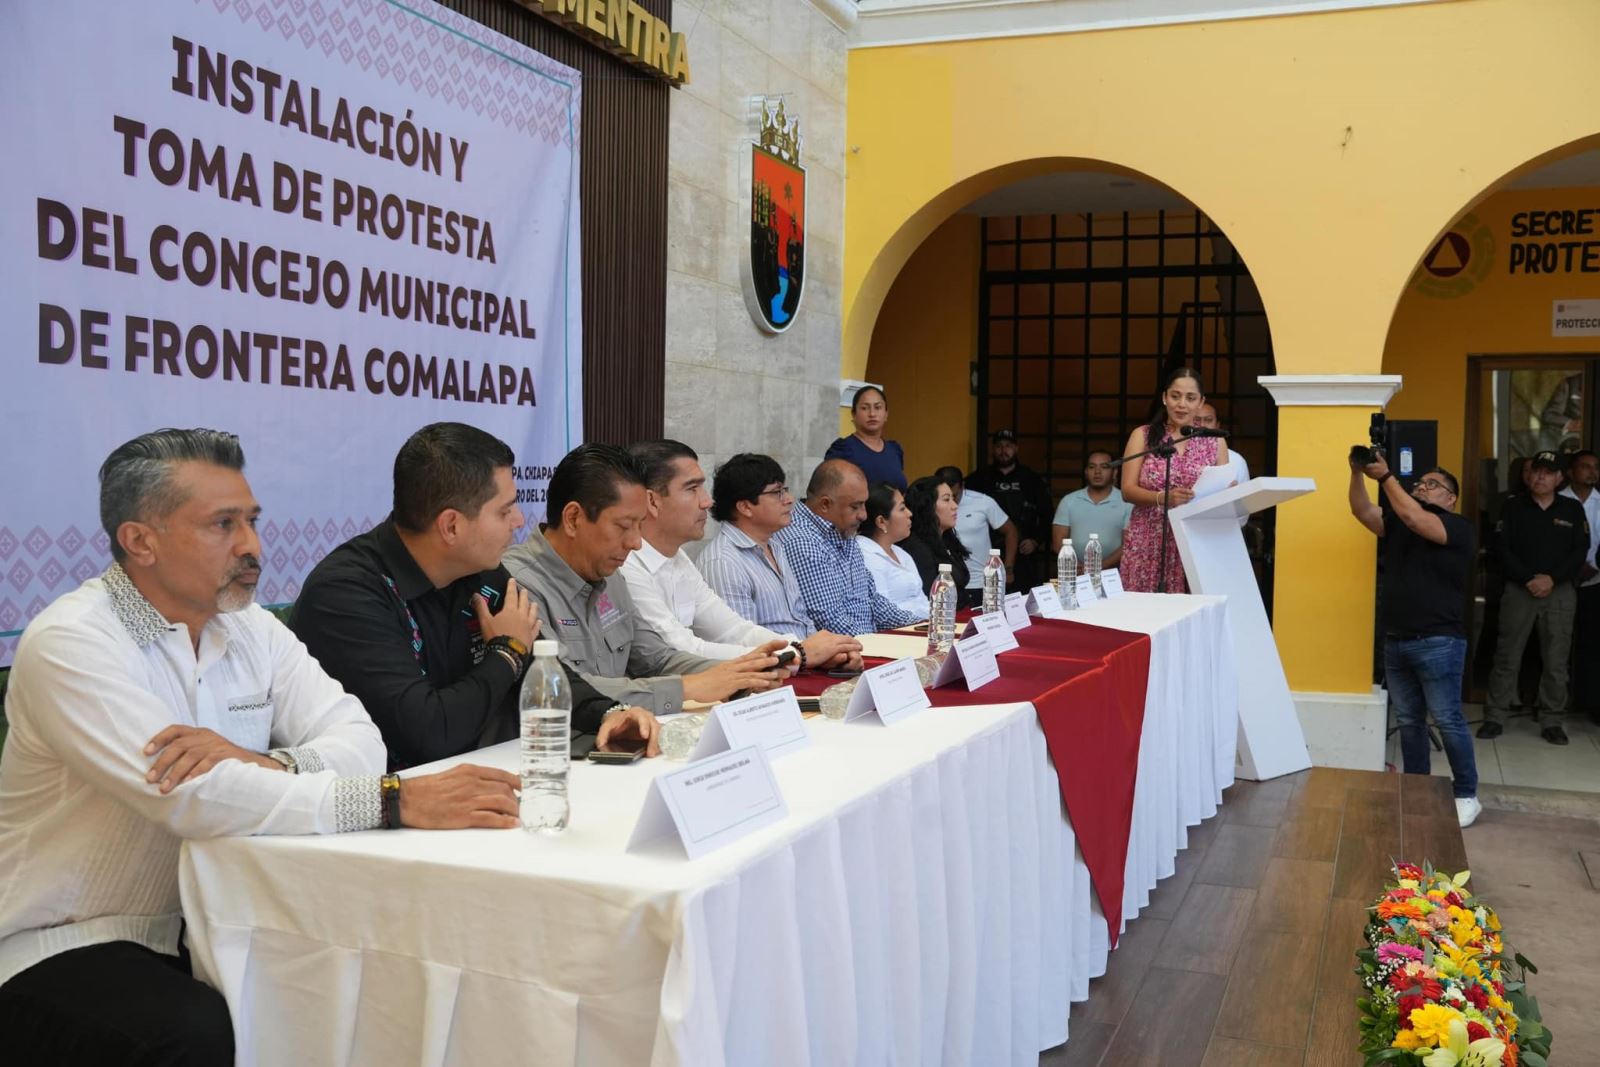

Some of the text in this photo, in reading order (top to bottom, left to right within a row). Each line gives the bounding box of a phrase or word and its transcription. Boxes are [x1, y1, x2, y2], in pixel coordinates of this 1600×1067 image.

[172, 35, 469, 183] INSTALACIÓN Y
[113, 114, 497, 265] TOMA DE PROTESTA
[37, 197, 537, 340] DEL CONCEJO MUNICIPAL
[38, 302, 538, 408] DE FRONTERA COMALAPA
[526, 488, 539, 503] DEL
